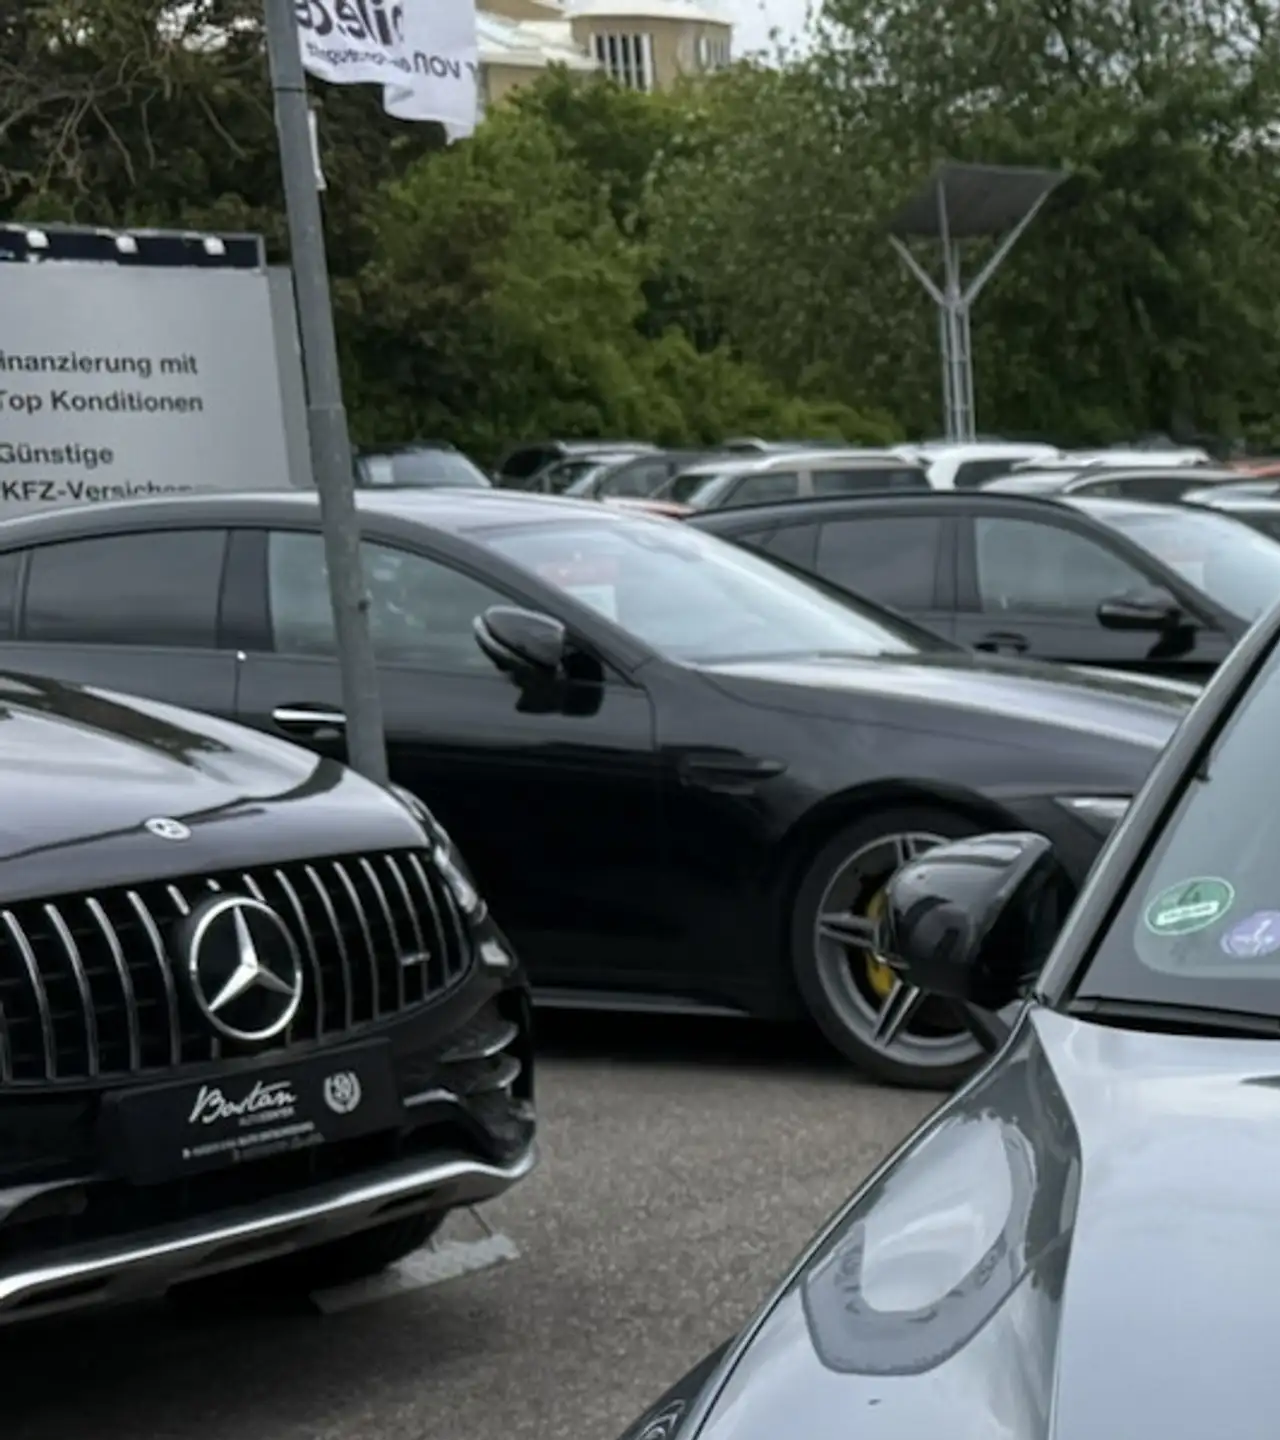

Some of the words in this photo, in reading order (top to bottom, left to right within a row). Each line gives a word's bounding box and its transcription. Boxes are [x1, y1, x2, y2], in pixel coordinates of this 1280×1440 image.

[160, 352, 198, 375] mit
[51, 388, 204, 413] Konditionen
[0, 442, 114, 469] Günstige
[188, 1080, 298, 1124] Bostan
